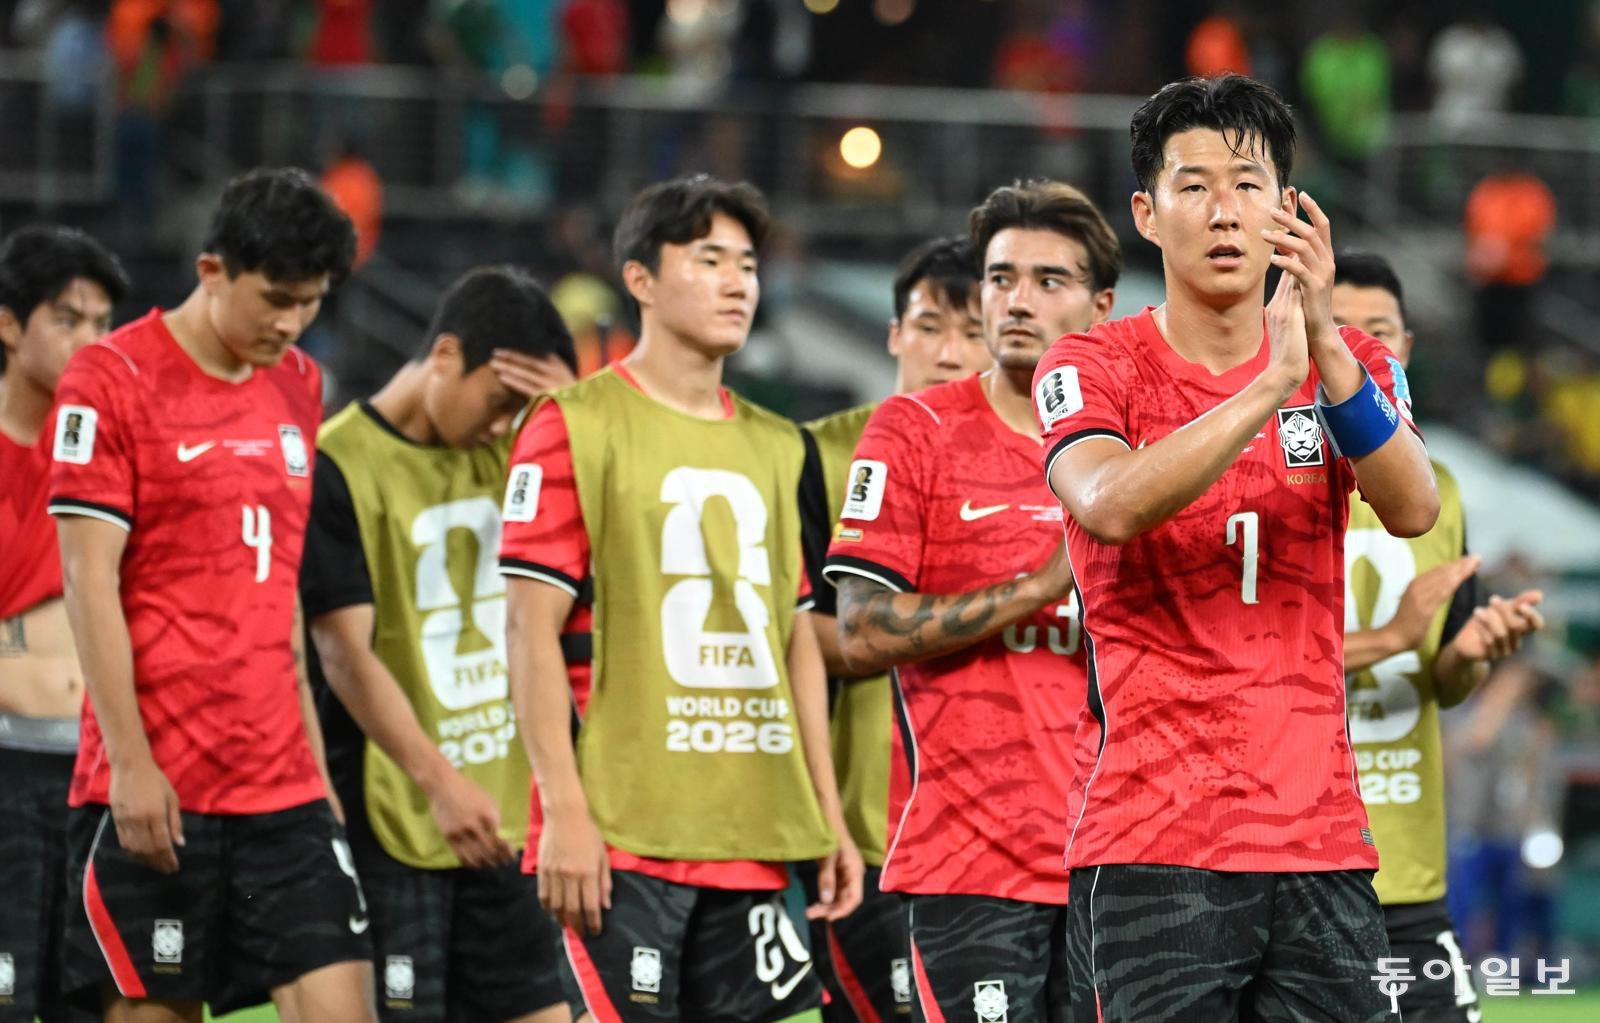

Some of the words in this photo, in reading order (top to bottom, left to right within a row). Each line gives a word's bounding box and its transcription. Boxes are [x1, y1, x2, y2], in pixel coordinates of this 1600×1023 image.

[1286, 473, 1328, 486] KOREA
[241, 504, 273, 583] 4
[1225, 511, 1260, 605] 7
[699, 645, 755, 668] FIFA
[665, 696, 741, 718] WORLD
[744, 698, 789, 719] CUP
[666, 720, 794, 754] 2026
[1375, 748, 1422, 771] CUP
[1360, 771, 1422, 804] 26
